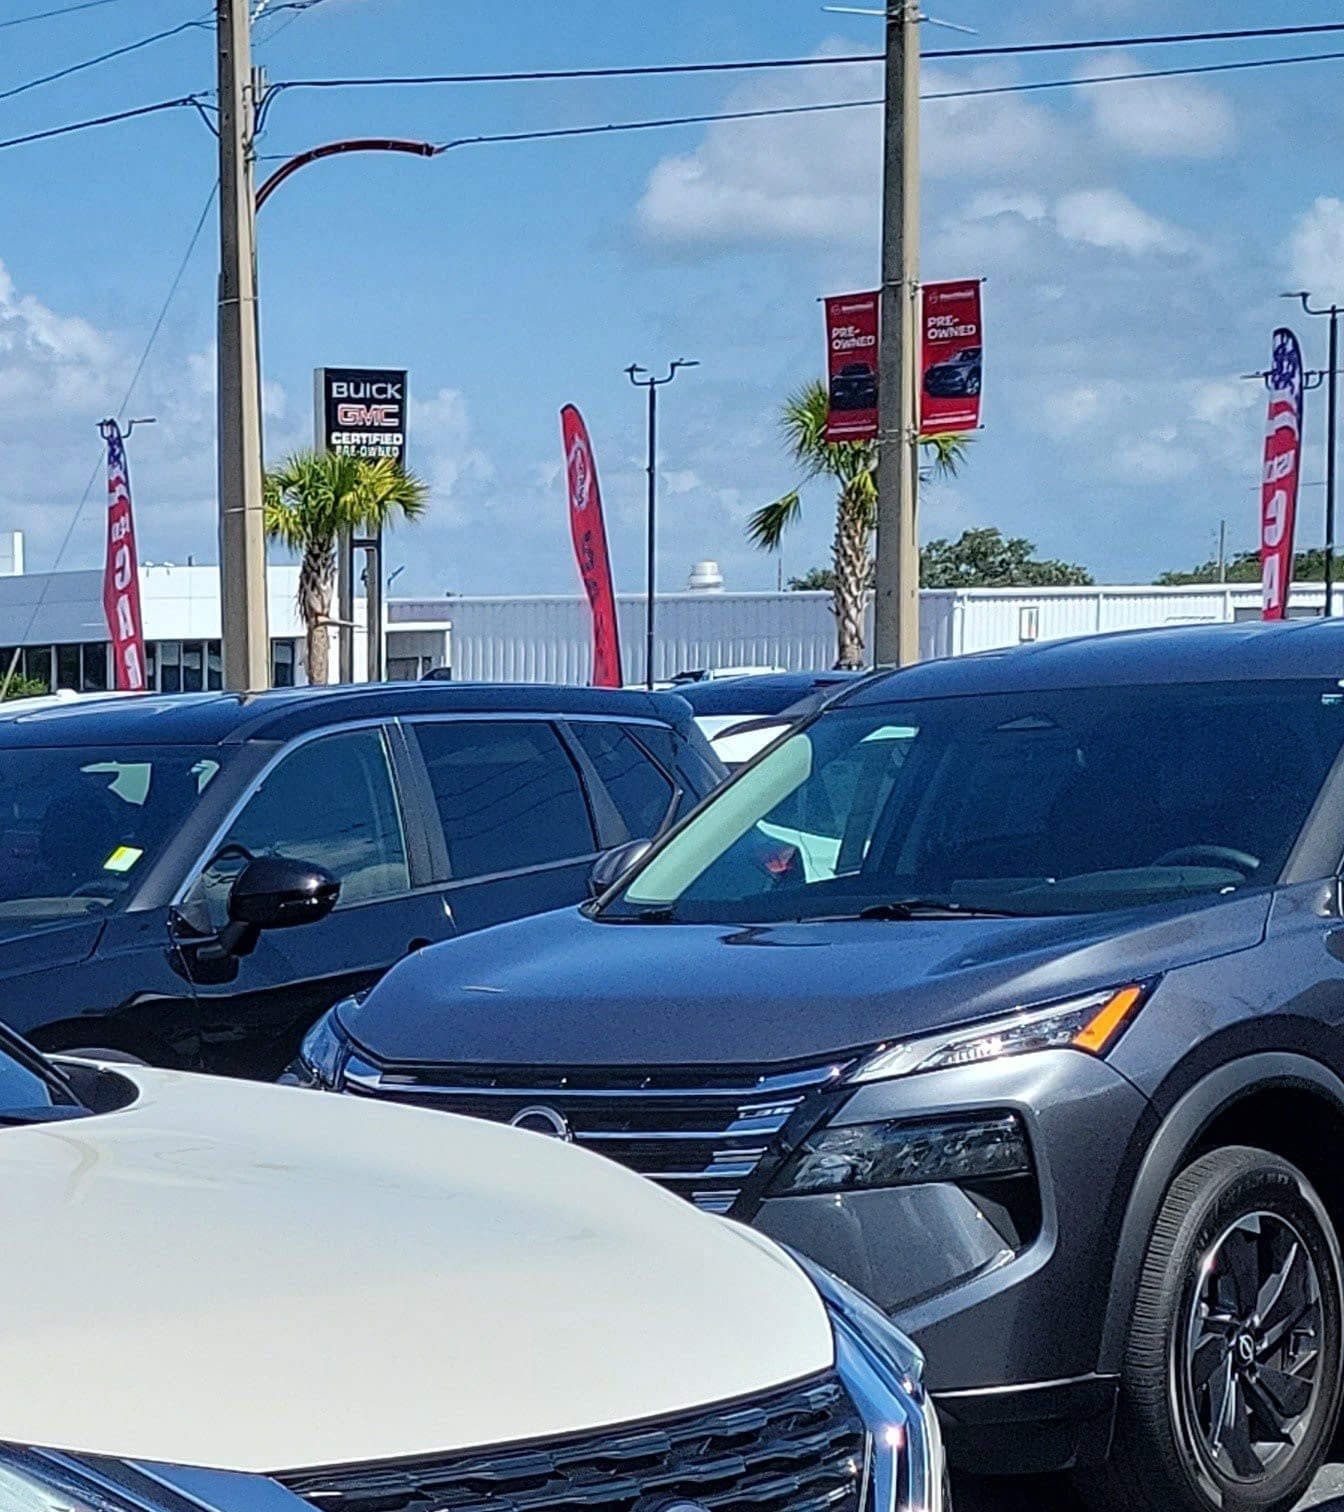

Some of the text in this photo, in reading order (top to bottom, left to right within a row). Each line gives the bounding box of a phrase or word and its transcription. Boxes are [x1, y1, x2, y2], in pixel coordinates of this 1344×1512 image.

[927, 315, 959, 328] PRE-
[927, 324, 976, 339] OWNED
[832, 335, 875, 350] OWNED
[332, 382, 402, 399] BUICK
[338, 403, 399, 426] GMC
[331, 431, 403, 445] CERTIFIED
